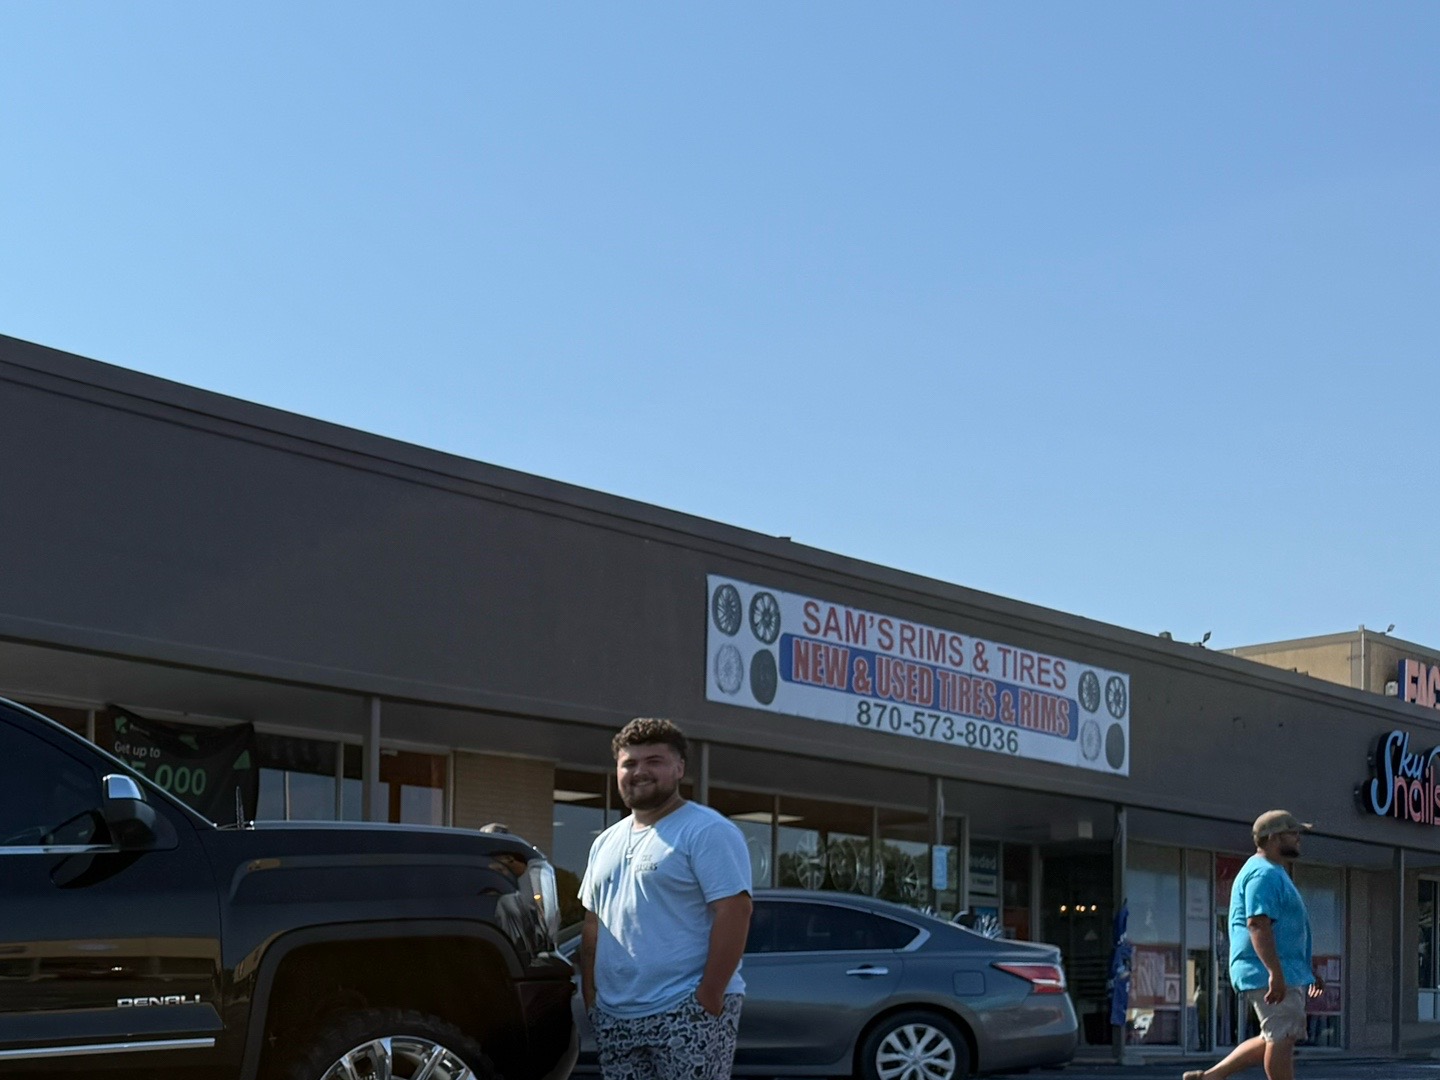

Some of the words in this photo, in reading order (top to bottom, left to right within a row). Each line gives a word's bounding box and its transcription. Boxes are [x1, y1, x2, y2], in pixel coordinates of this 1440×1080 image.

[803, 601, 894, 651] SAM'S
[900, 625, 964, 667] RIMS
[973, 642, 990, 674] &
[997, 646, 1067, 691] TIRES
[792, 639, 848, 688] NEW
[852, 657, 872, 696] &
[876, 655, 934, 708] USED
[937, 672, 996, 721] TIRES
[1000, 694, 1016, 724] &
[1018, 692, 1070, 738] RIMS
[114, 740, 131, 753] Get
[133, 746, 148, 758] up
[149, 746, 161, 758] to
[856, 701, 1019, 754] 870-573-8036
[1371, 730, 1425, 816] Sky
[117, 994, 201, 1007] DENALI
